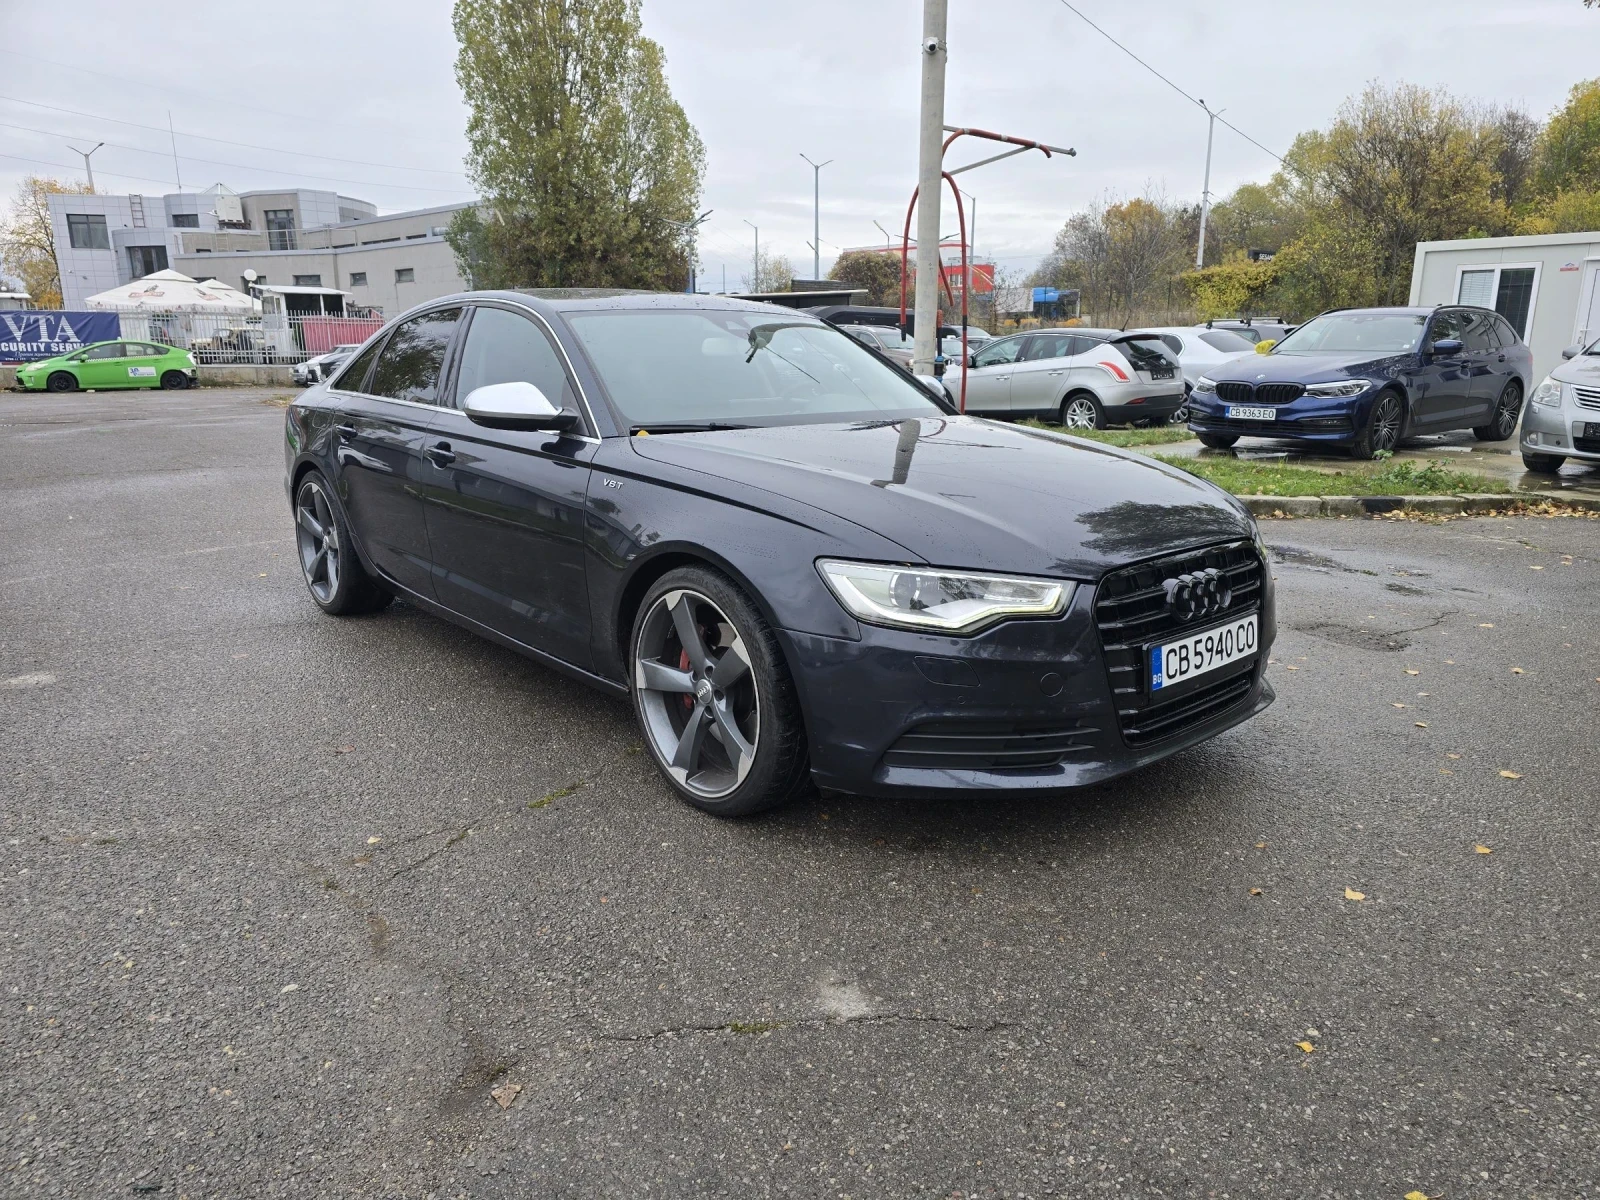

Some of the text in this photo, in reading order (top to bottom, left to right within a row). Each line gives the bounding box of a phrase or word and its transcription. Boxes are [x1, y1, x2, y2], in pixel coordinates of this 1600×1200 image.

[0, 314, 81, 342] VTA
[0, 342, 45, 352] CURITY
[1242, 409, 1262, 418] 9363
[1166, 620, 1255, 679] CB 5940 CO
[1152, 673, 1162, 685] BG
